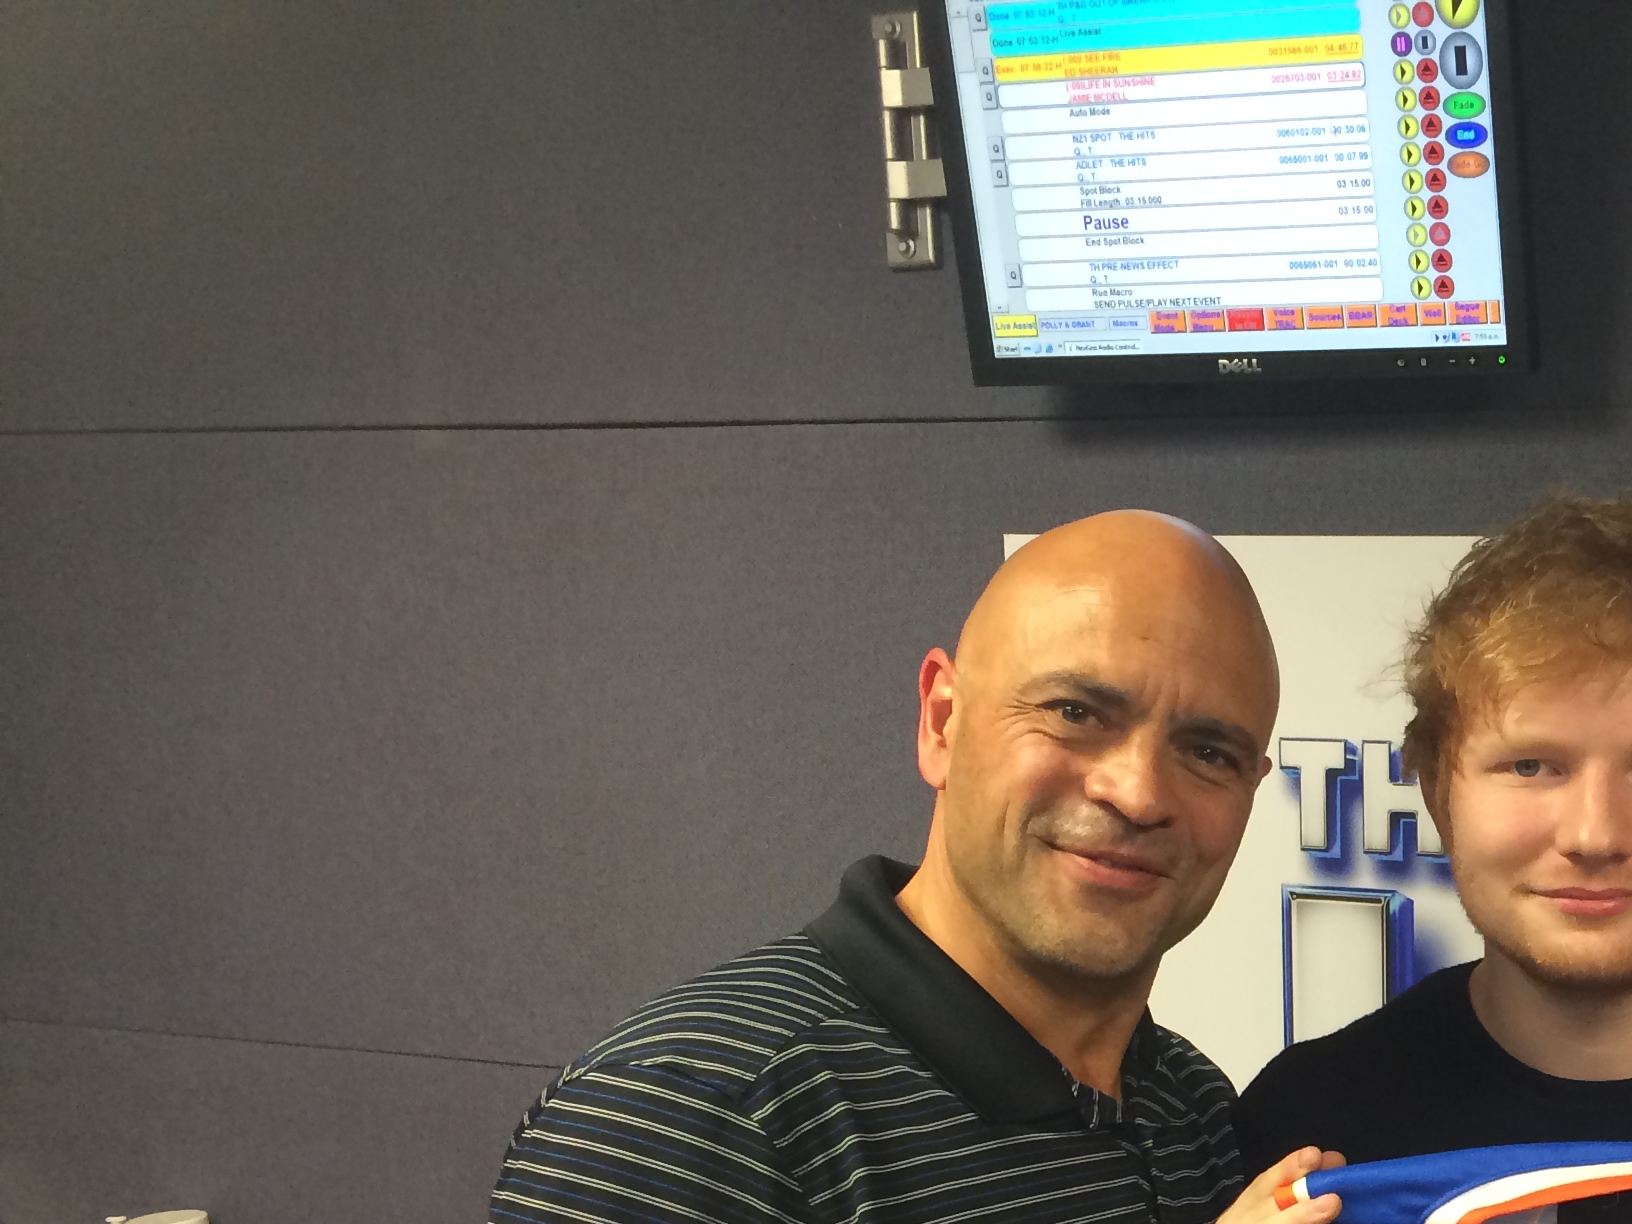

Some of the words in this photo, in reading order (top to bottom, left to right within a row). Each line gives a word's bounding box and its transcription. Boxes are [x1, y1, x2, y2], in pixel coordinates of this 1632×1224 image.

[1078, 66, 1118, 76] SHEERAN
[1113, 77, 1156, 88] SUNSHINE
[1453, 100, 1475, 110] Fade
[1069, 108, 1087, 118] Auto
[1089, 107, 1111, 116] Mode
[1090, 133, 1112, 143] SPOT
[1118, 131, 1134, 141] THE
[1136, 130, 1156, 140] HITS
[1456, 129, 1475, 140] End
[1109, 158, 1125, 168] THE
[1127, 157, 1147, 167] HITS
[1080, 187, 1098, 196] Spot
[1099, 186, 1121, 195] Block
[1083, 214, 1130, 231] Pause
[1085, 238, 1101, 247] End
[1104, 237, 1121, 247] Spot
[1123, 236, 1145, 245] Block
[1089, 263, 1100, 272] TH
[1147, 260, 1179, 269] EFFECT
[1110, 287, 1133, 296] Macro
[1094, 300, 1117, 309] SEND
[1169, 297, 1192, 307] NEXT
[1194, 296, 1221, 306] EVENT
[1040, 321, 1063, 329] POLLY
[1071, 320, 1096, 328] GRANT
[1112, 319, 1138, 328] Macros
[1217, 358, 1262, 375] DELL
